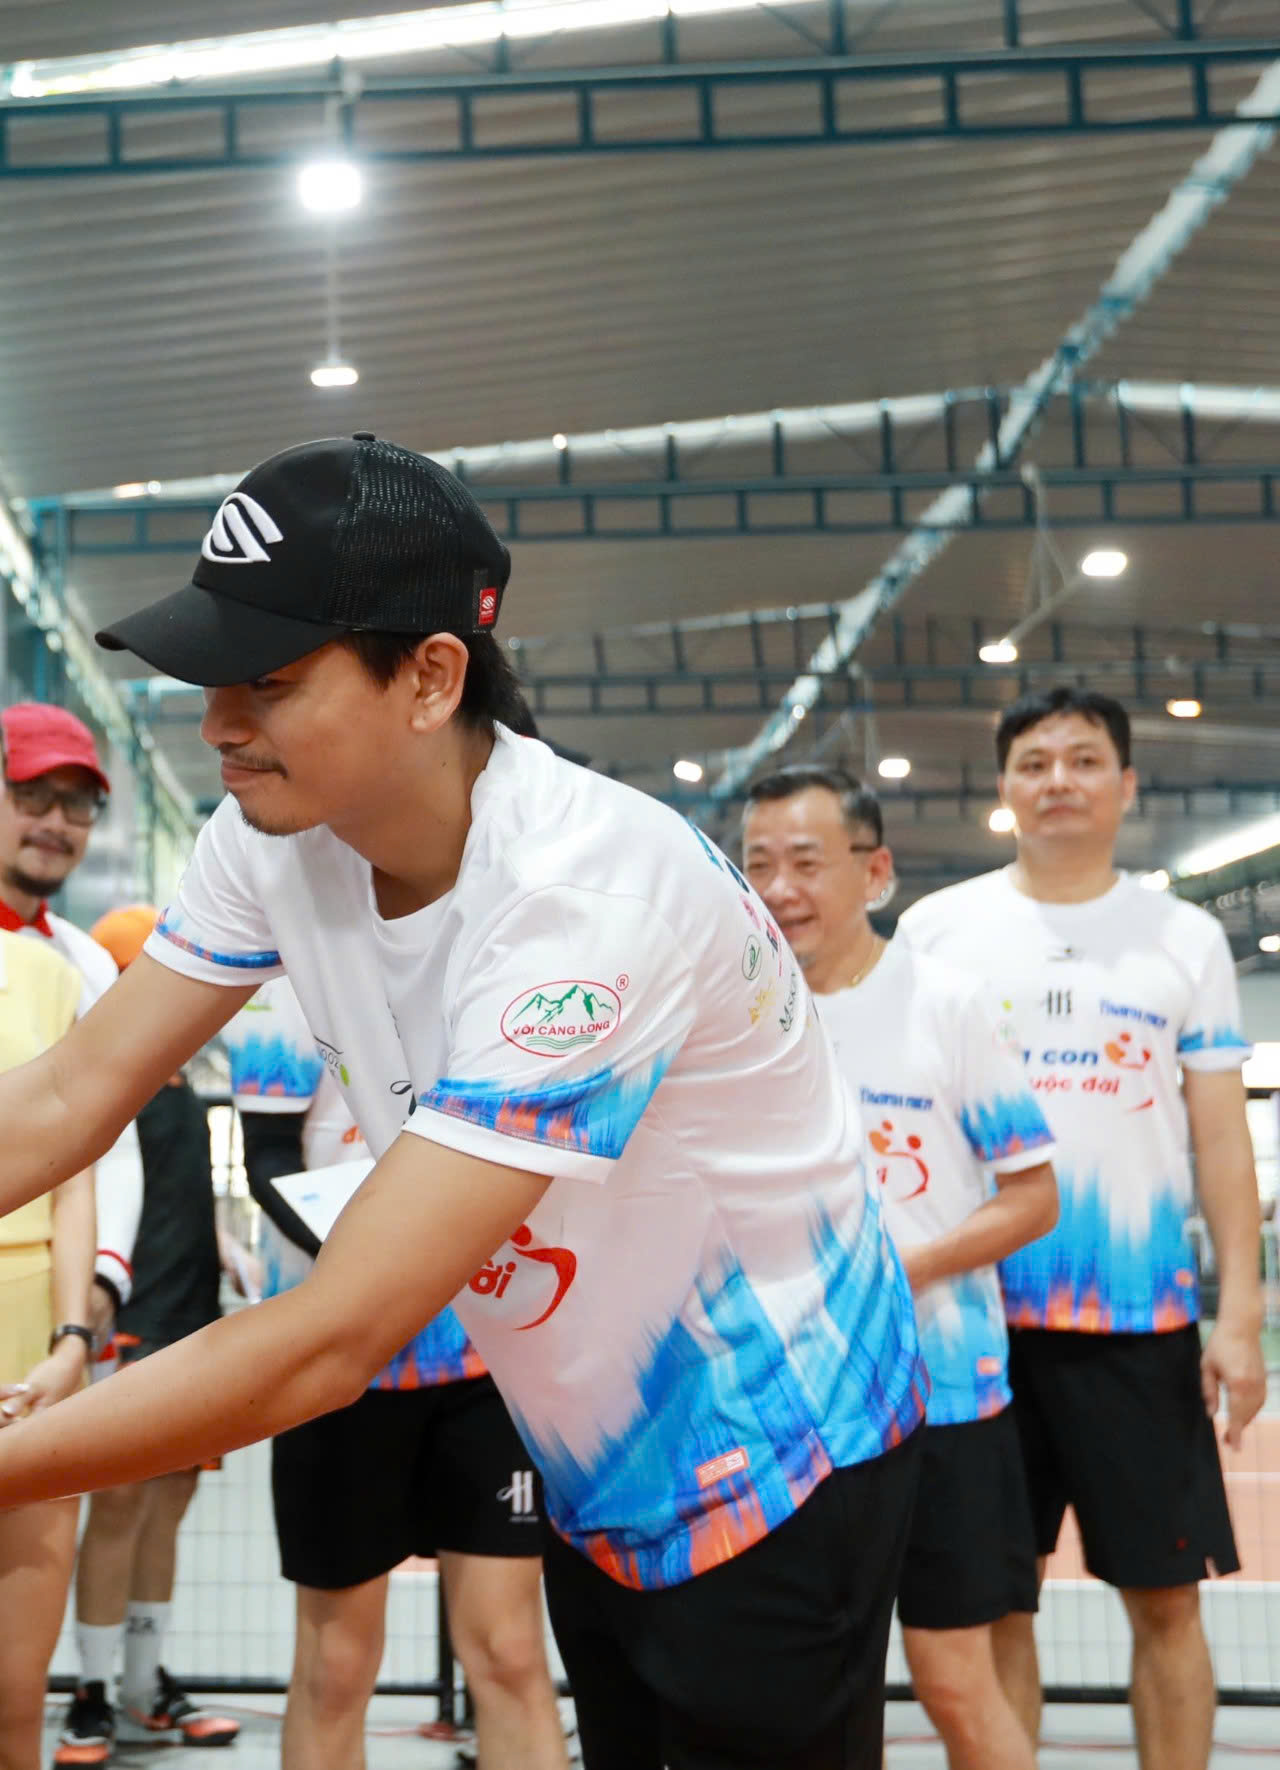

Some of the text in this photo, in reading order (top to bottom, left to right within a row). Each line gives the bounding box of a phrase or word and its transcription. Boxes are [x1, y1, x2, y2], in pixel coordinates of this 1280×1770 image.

[538, 1024, 576, 1036] CÀNG
[580, 1020, 610, 1034] LONG
[1042, 1050, 1099, 1066] con
[469, 1258, 516, 1299] ời
